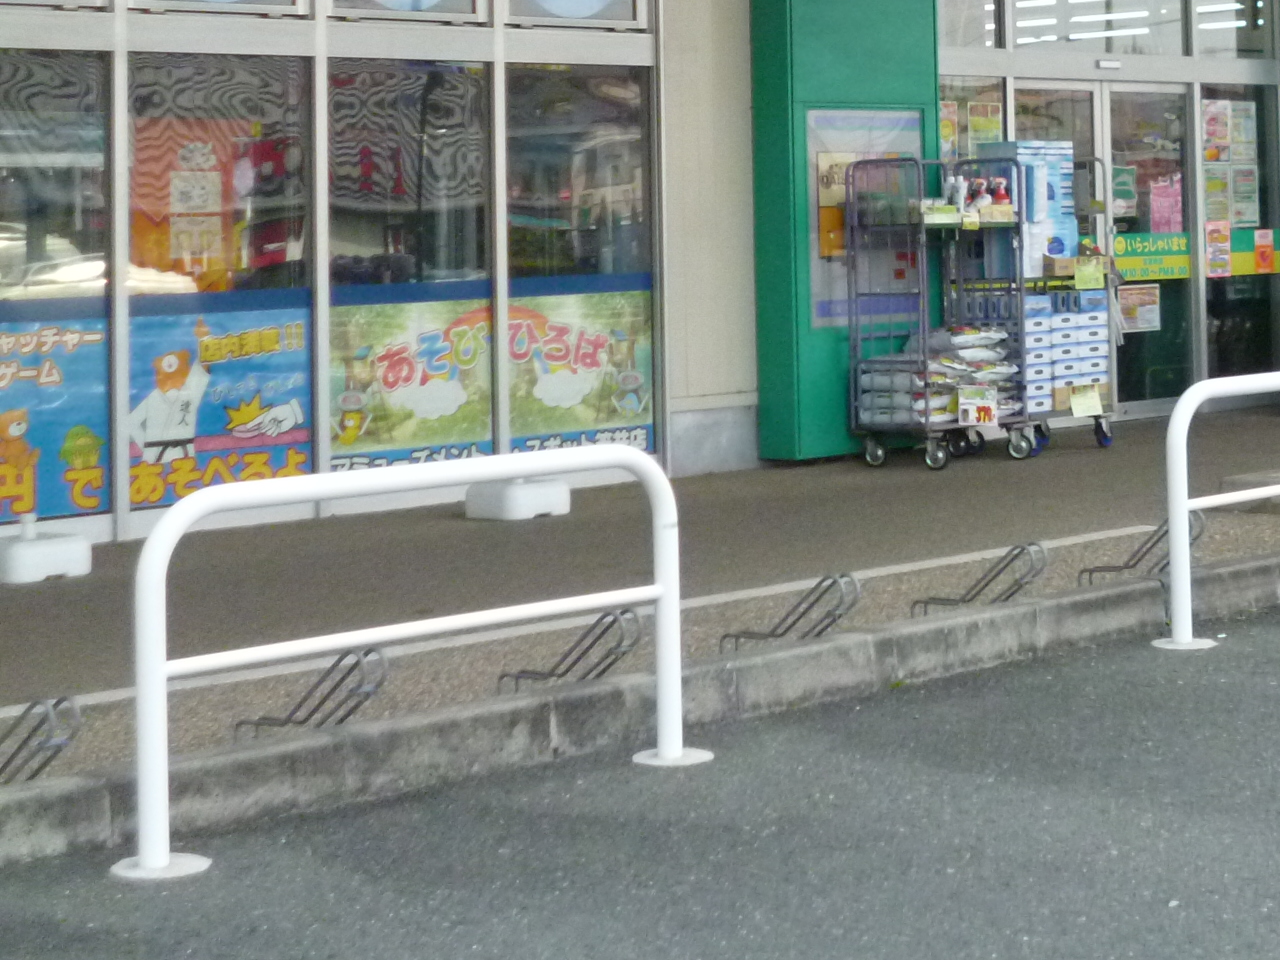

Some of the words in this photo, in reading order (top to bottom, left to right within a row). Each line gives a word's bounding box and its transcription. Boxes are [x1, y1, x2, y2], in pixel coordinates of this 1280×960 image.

[1127, 236, 1188, 254] いらっしゃいませ
[375, 321, 488, 391] あそび
[507, 319, 610, 370] ひろば
